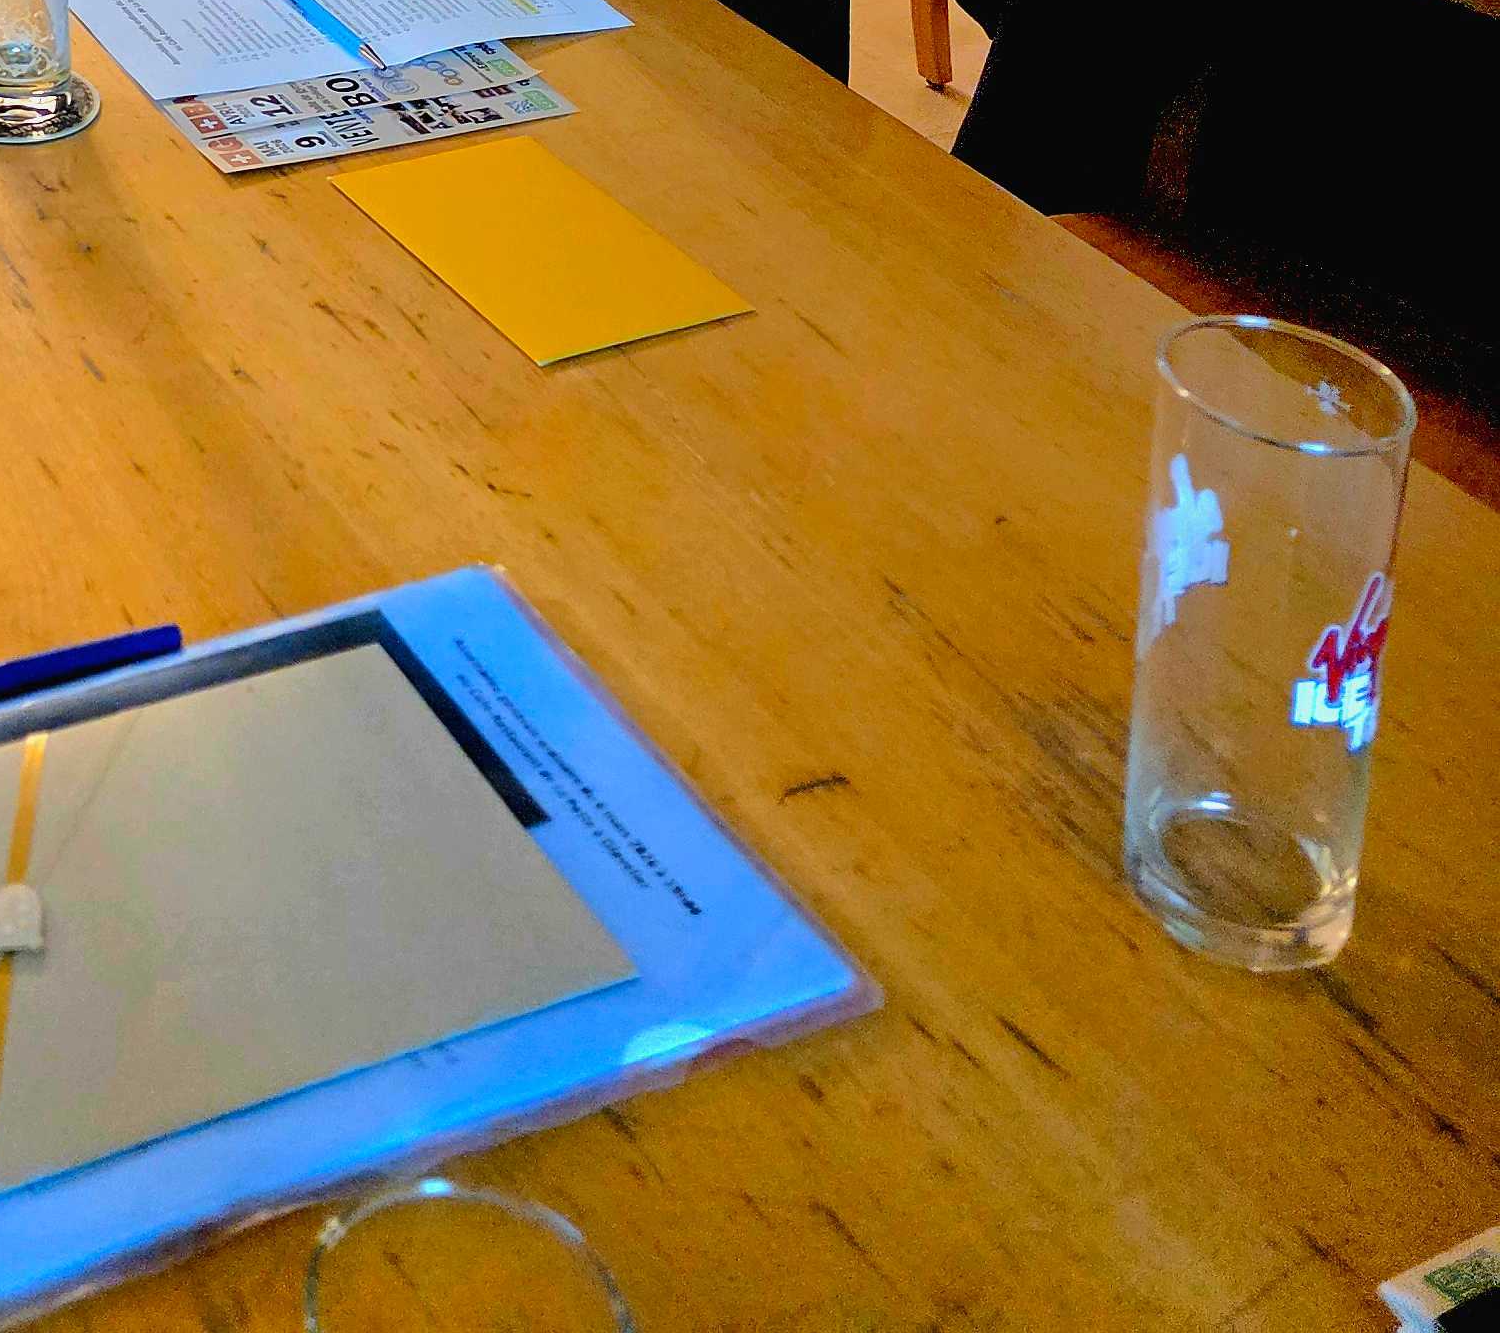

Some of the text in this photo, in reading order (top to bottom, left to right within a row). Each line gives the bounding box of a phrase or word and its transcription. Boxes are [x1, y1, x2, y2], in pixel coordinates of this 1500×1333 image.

[212, 101, 247, 125] AVRIL
[250, 94, 293, 117] 12
[319, 110, 380, 147] VENTE
[253, 140, 282, 157] MAI
[295, 136, 327, 148] 9
